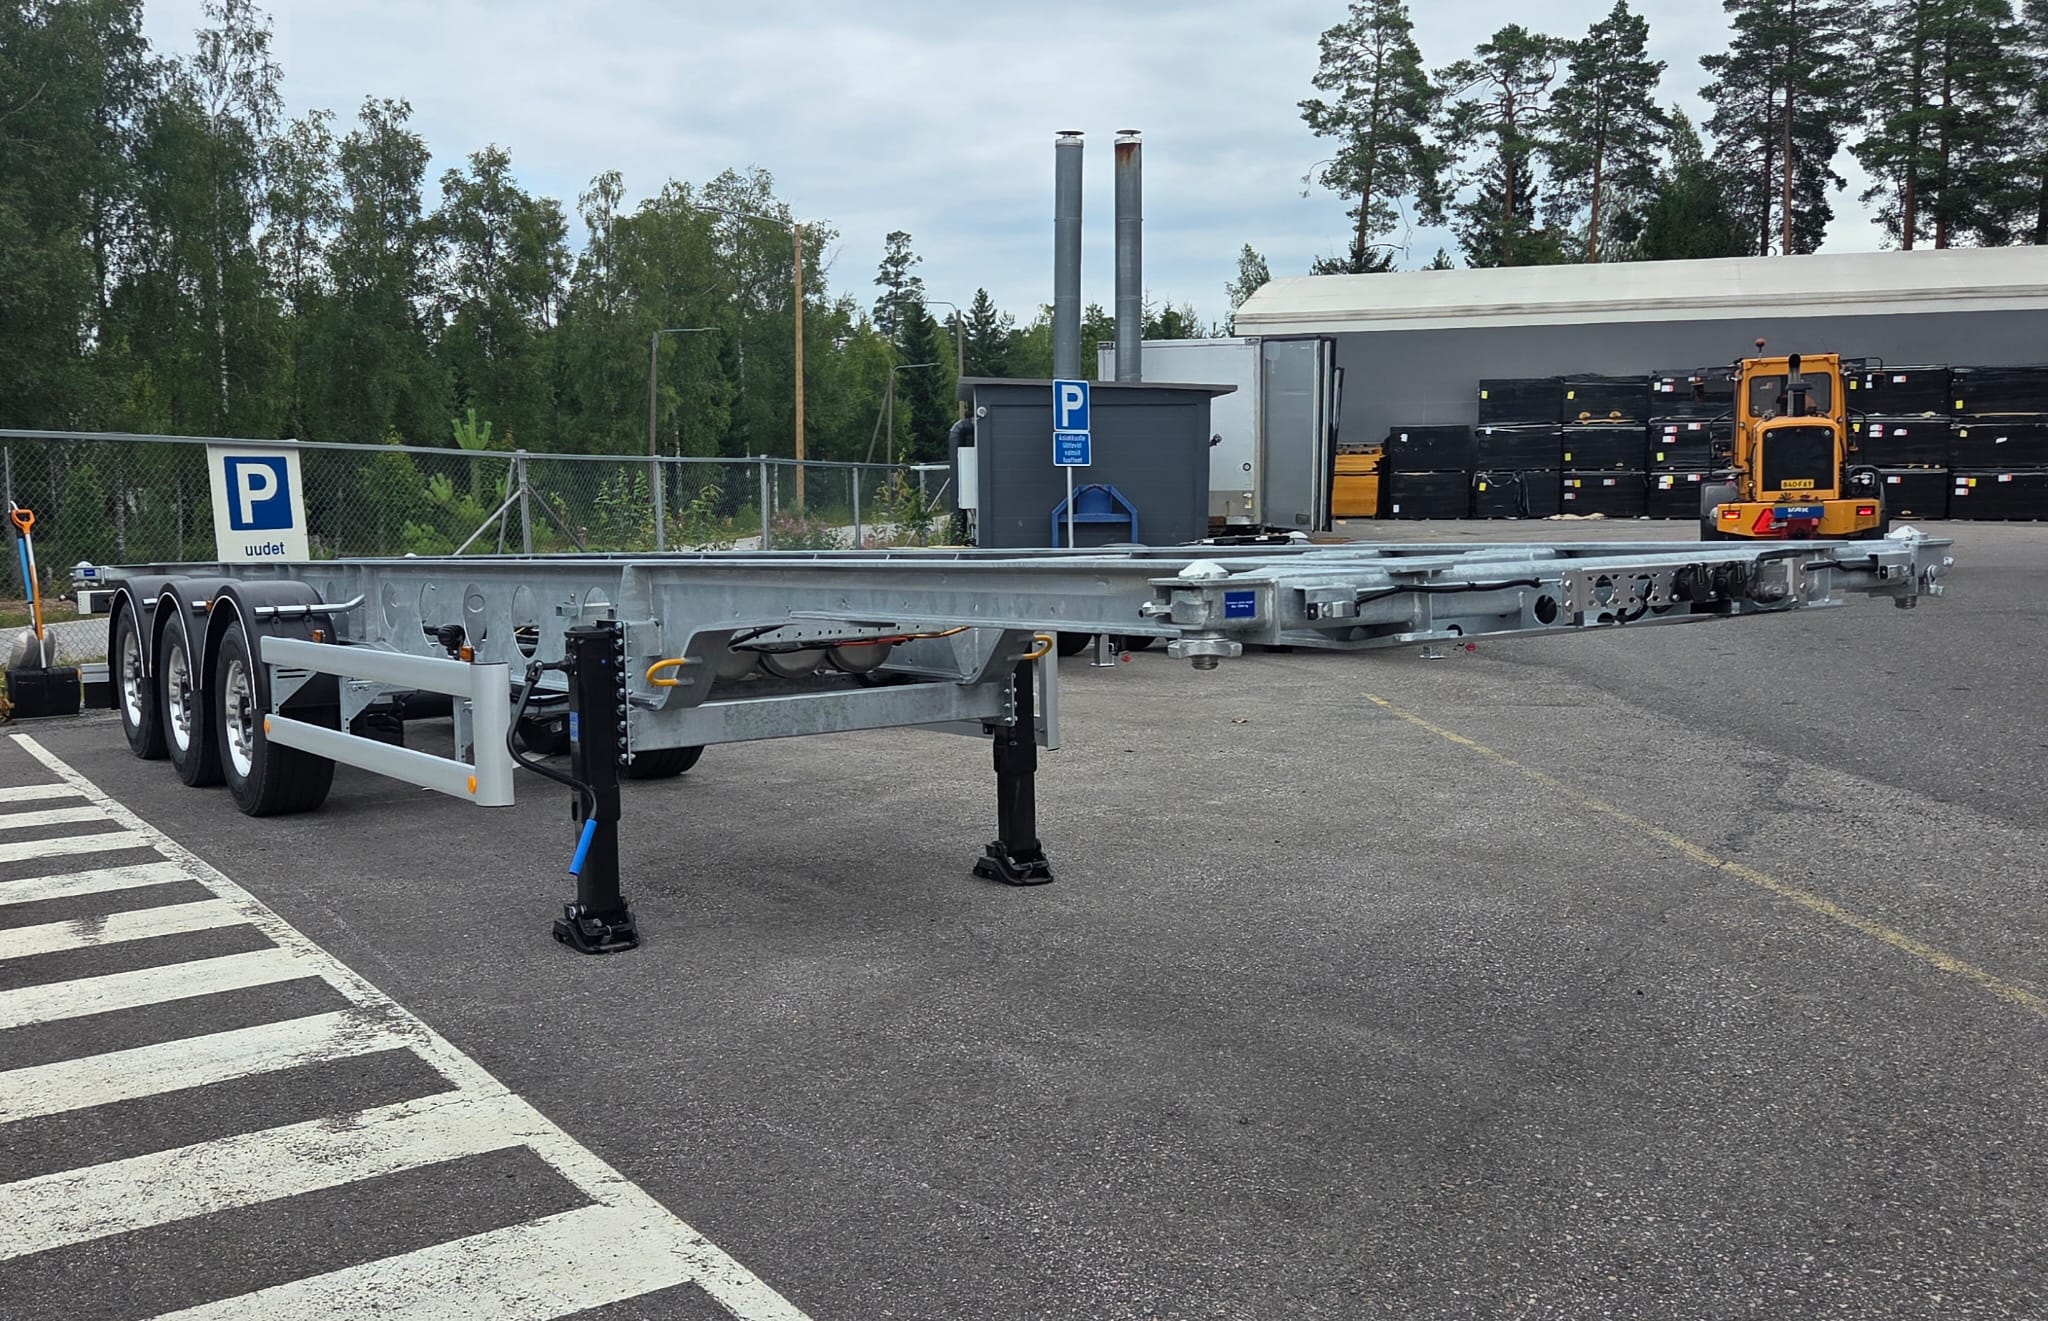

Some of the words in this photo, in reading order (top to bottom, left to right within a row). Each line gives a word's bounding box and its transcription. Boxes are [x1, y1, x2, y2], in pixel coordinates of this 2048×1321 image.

[1061, 384, 1084, 427] P
[236, 463, 278, 524] P
[245, 541, 285, 556] uudet
